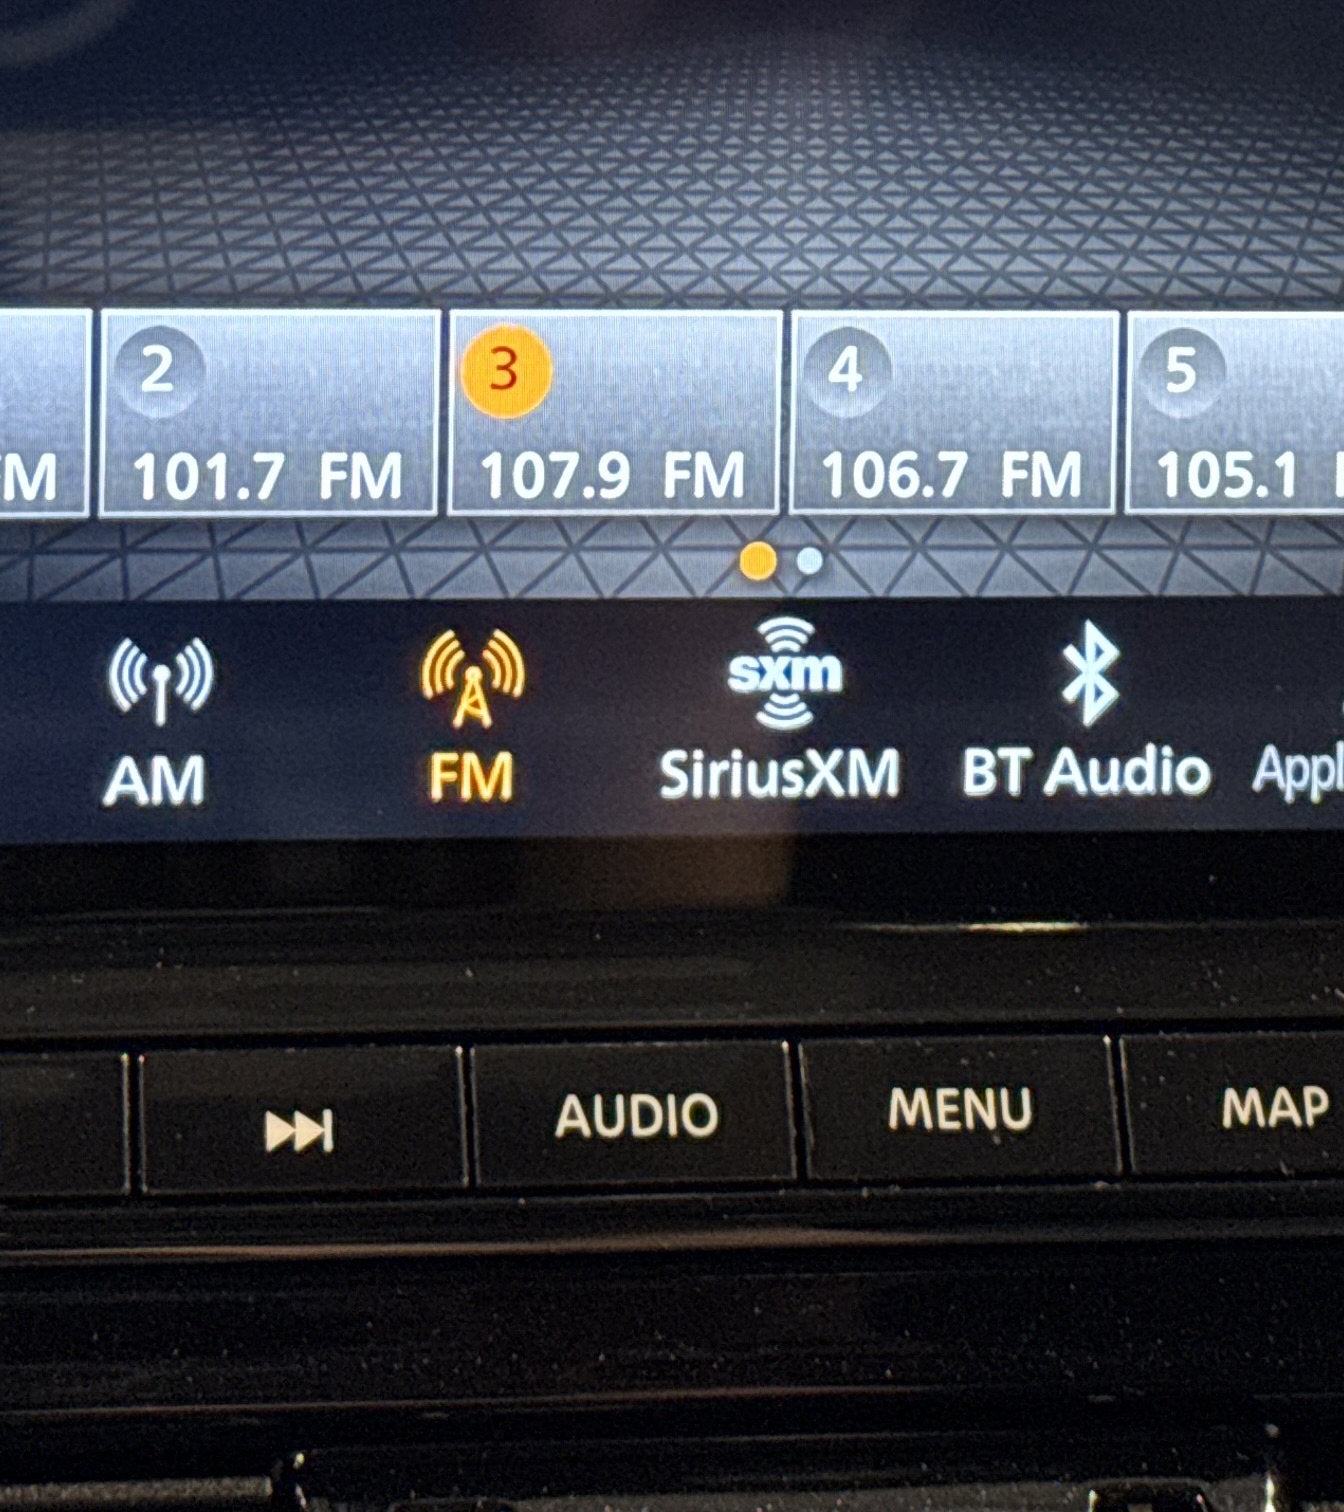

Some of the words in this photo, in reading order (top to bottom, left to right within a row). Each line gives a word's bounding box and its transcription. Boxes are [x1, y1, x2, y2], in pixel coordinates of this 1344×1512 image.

[140, 344, 174, 393] 2
[489, 345, 519, 392] 3
[827, 344, 863, 393] 4
[1164, 346, 1197, 394] 5
[133, 451, 286, 501] 101.7
[319, 451, 403, 501] FM
[480, 451, 632, 500] 107.9
[663, 451, 746, 499] FM
[821, 450, 969, 500] 106.7
[1001, 451, 1083, 499] FM
[1157, 450, 1297, 499] 105.1
[726, 653, 844, 694] sxm
[102, 754, 206, 807] AM
[429, 750, 514, 802] FM
[659, 747, 901, 800] SiriusXM
[962, 746, 1034, 796] BT
[1042, 742, 1212, 796] Audio
[553, 1092, 721, 1139] AUDIO
[886, 1086, 1034, 1133] MENU
[1221, 1085, 1331, 1129] MAP
